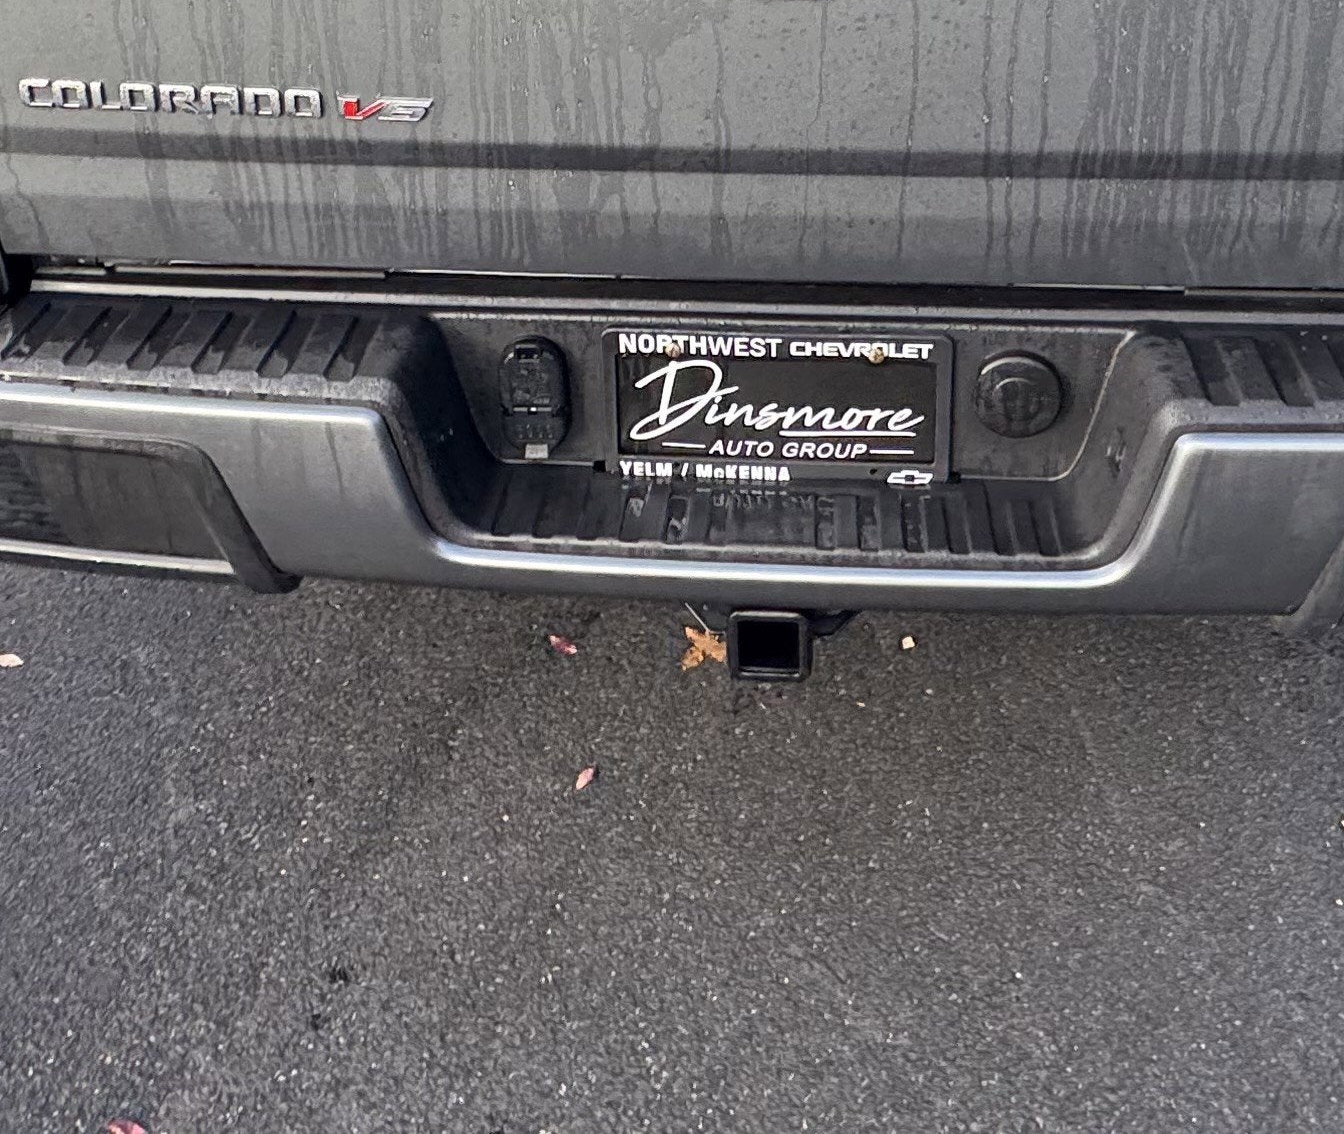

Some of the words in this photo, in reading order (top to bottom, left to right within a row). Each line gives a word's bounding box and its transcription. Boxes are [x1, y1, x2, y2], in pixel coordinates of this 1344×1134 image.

[18, 77, 324, 118] COLORADO
[619, 333, 782, 358] NORTHWEST
[789, 341, 934, 359] CHEVROLET
[629, 360, 926, 440] Dinsmore
[708, 440, 774, 458] AUTO
[781, 440, 869, 459] GROUP
[618, 460, 673, 478] YELM
[695, 464, 792, 482] McKENNA
